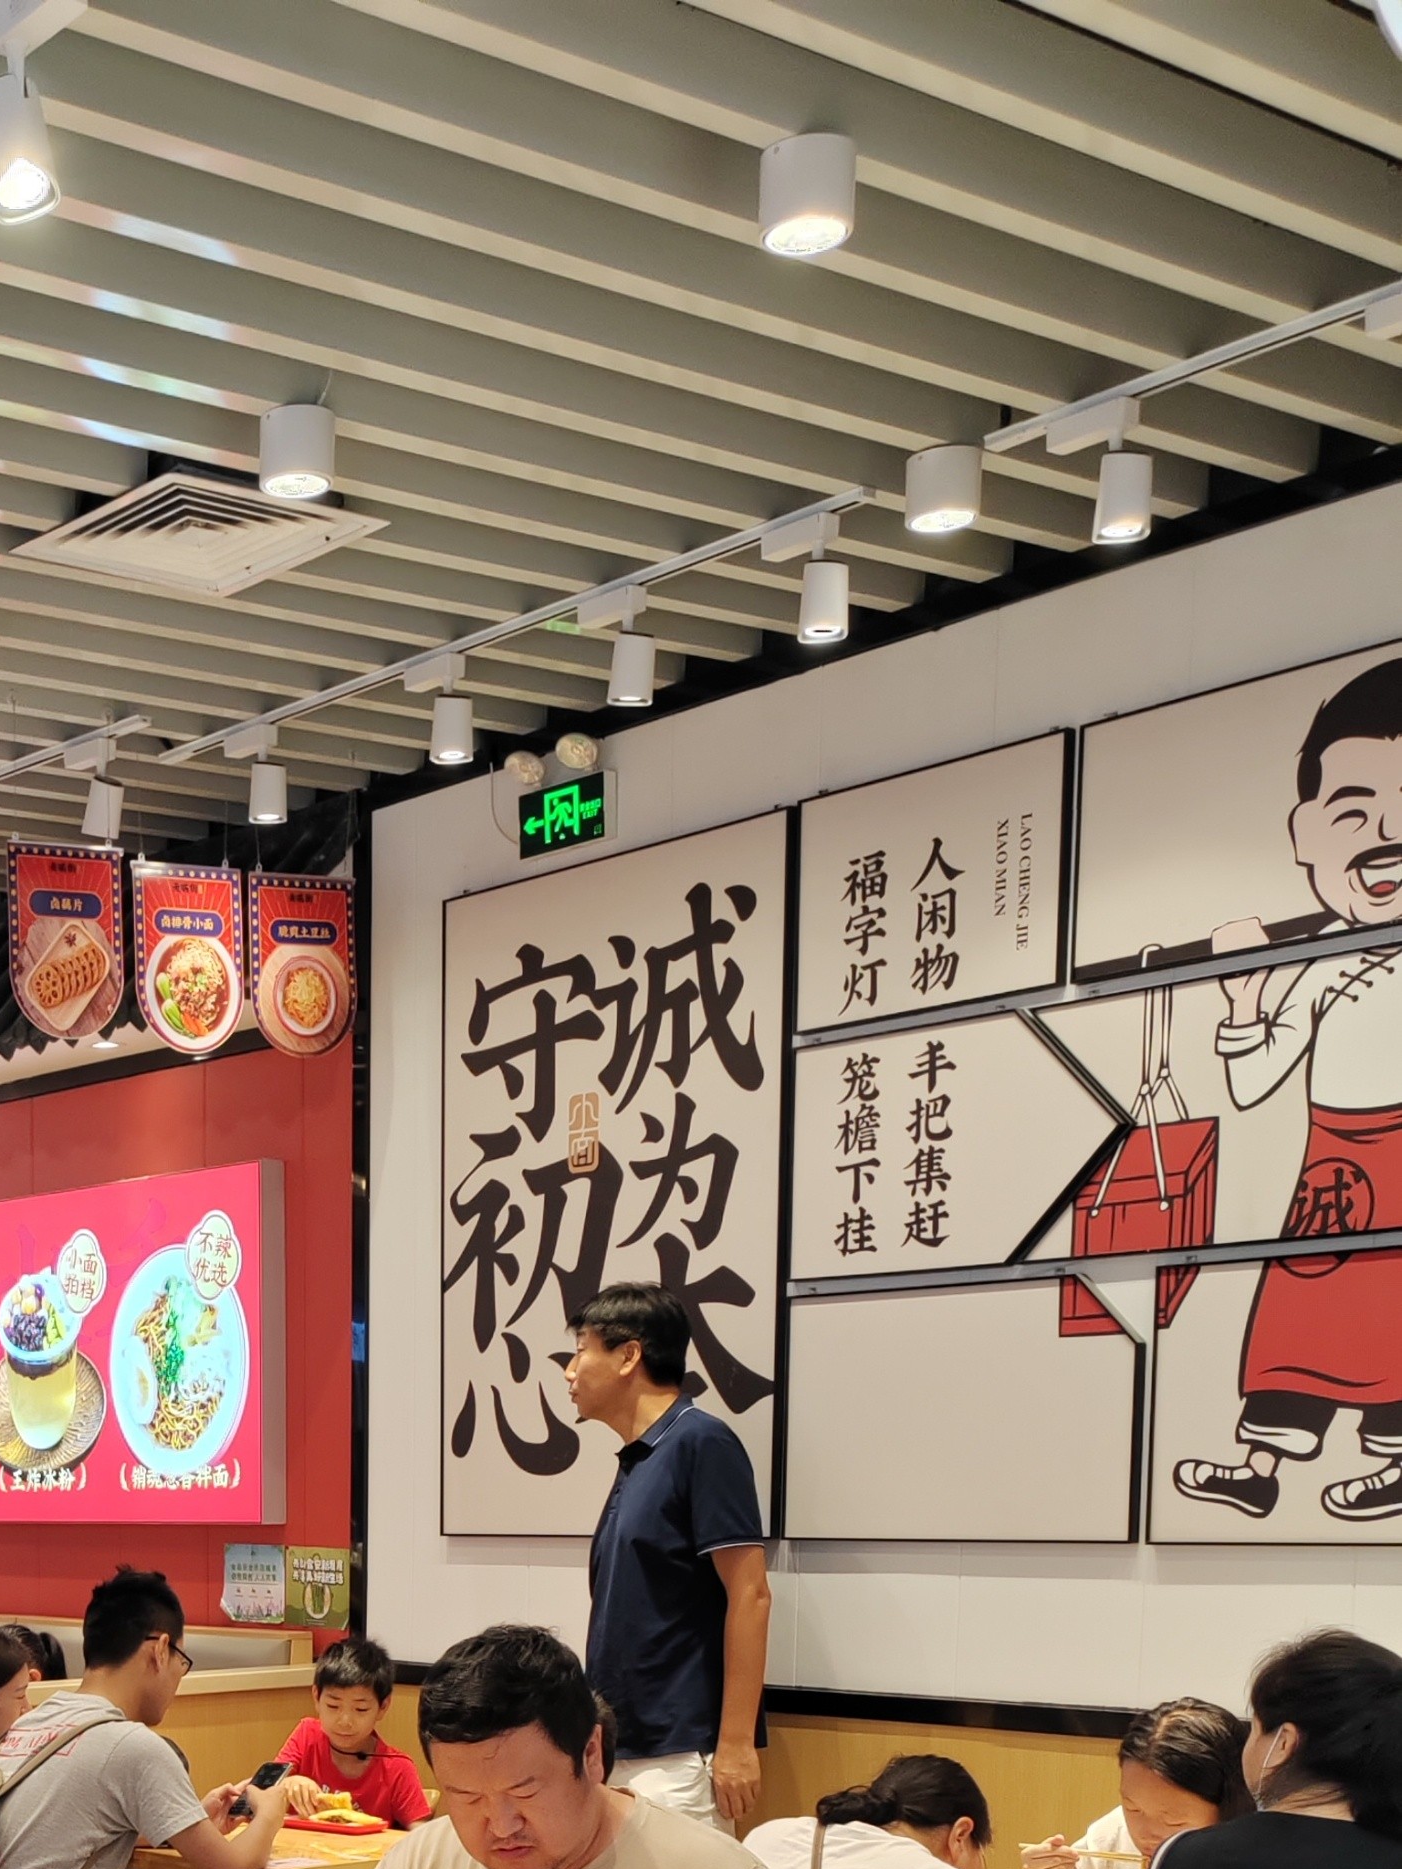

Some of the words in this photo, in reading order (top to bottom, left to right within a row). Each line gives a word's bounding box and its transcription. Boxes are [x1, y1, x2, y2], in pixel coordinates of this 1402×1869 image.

[995, 818, 1009, 865] XIAO
[1020, 812, 1033, 851] LAO
[994, 868, 1007, 917] MIAN
[1017, 855, 1032, 919] CHENG
[838, 849, 888, 1017] 福字灯
[909, 837, 966, 995] 人闲物
[1015, 923, 1029, 951] JIE
[833, 1052, 881, 1258] 笼檐下挂
[444, 943, 624, 1476] 守初心
[65, 1249, 99, 1275] 小面
[198, 1232, 233, 1259] 不辣
[63, 1275, 97, 1301] 拍档
[194, 1258, 229, 1286] 优选
